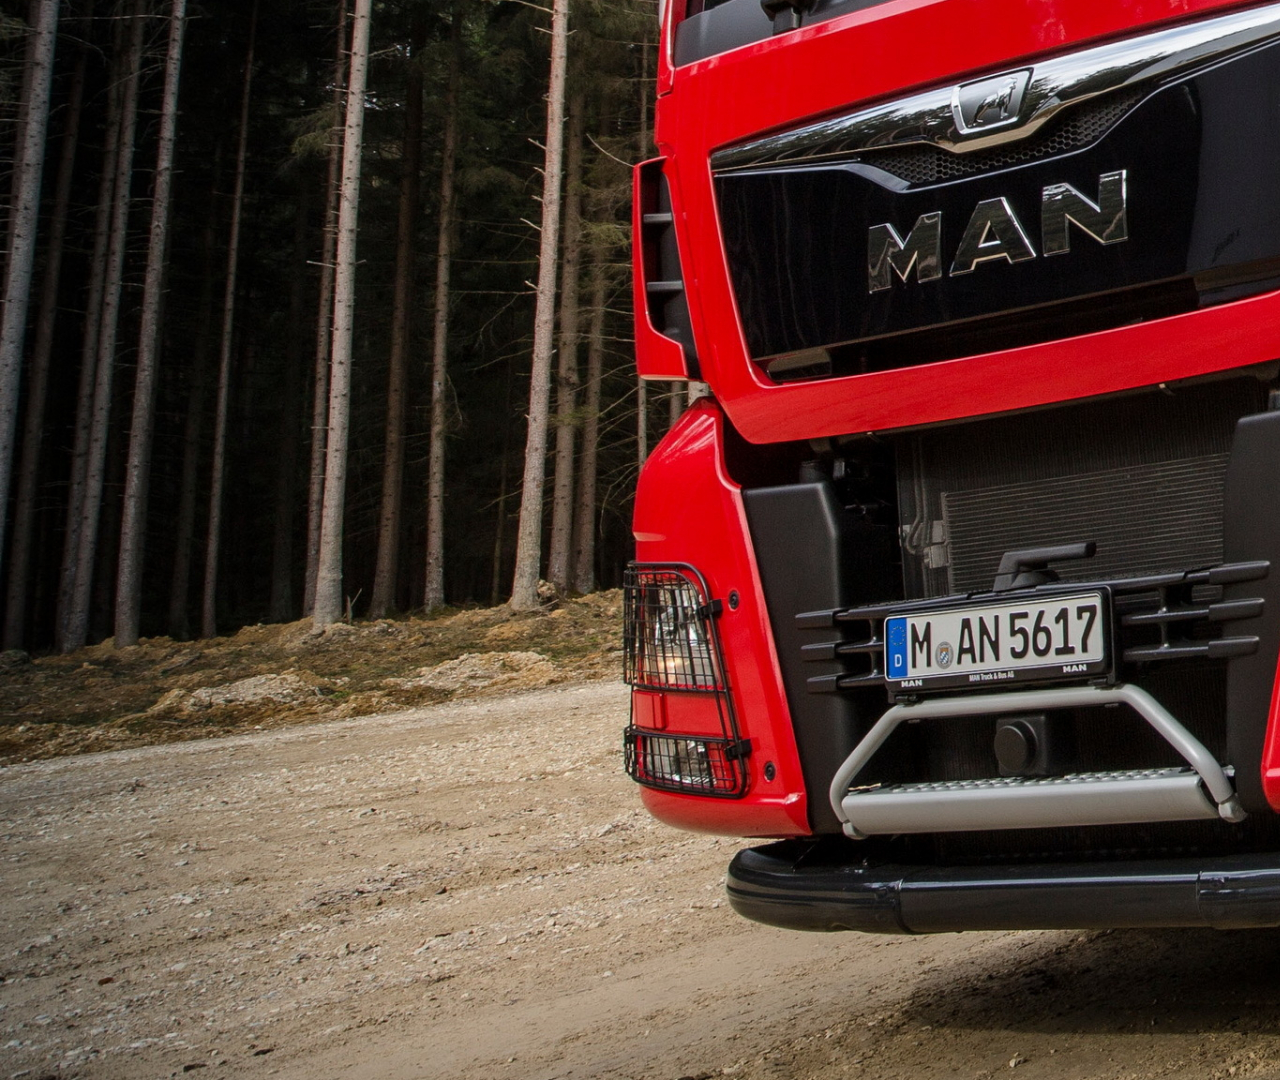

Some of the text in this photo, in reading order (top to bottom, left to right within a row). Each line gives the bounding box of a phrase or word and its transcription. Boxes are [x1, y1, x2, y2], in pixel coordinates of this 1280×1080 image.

[868, 169, 1128, 294] MAN
[894, 604, 1098, 669] D M AN 5617
[901, 679, 923, 688] MAN
[1062, 664, 1087, 673] MAN
